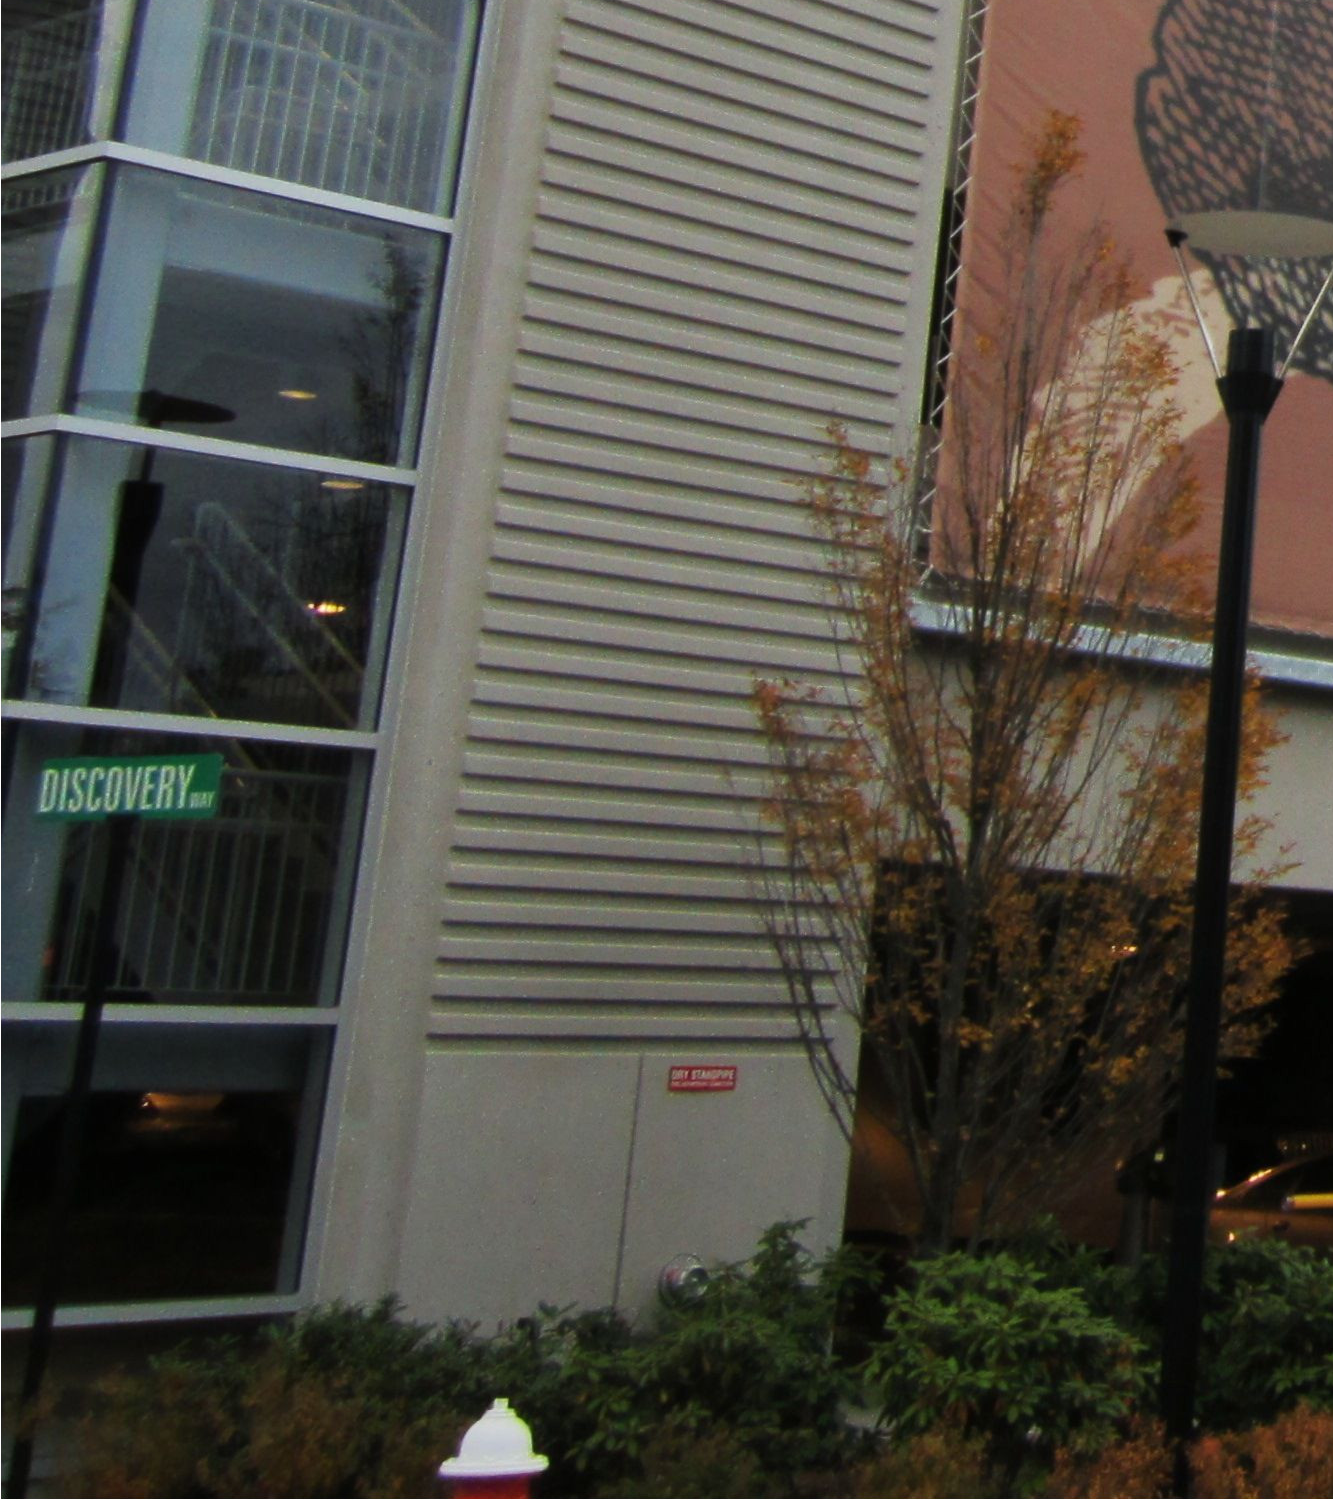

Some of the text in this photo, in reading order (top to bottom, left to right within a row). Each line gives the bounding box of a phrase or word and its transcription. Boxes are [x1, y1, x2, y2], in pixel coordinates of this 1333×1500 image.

[38, 764, 216, 812] DISCOVERY WAY
[672, 1069, 734, 1080] DRY STANDPIPE
